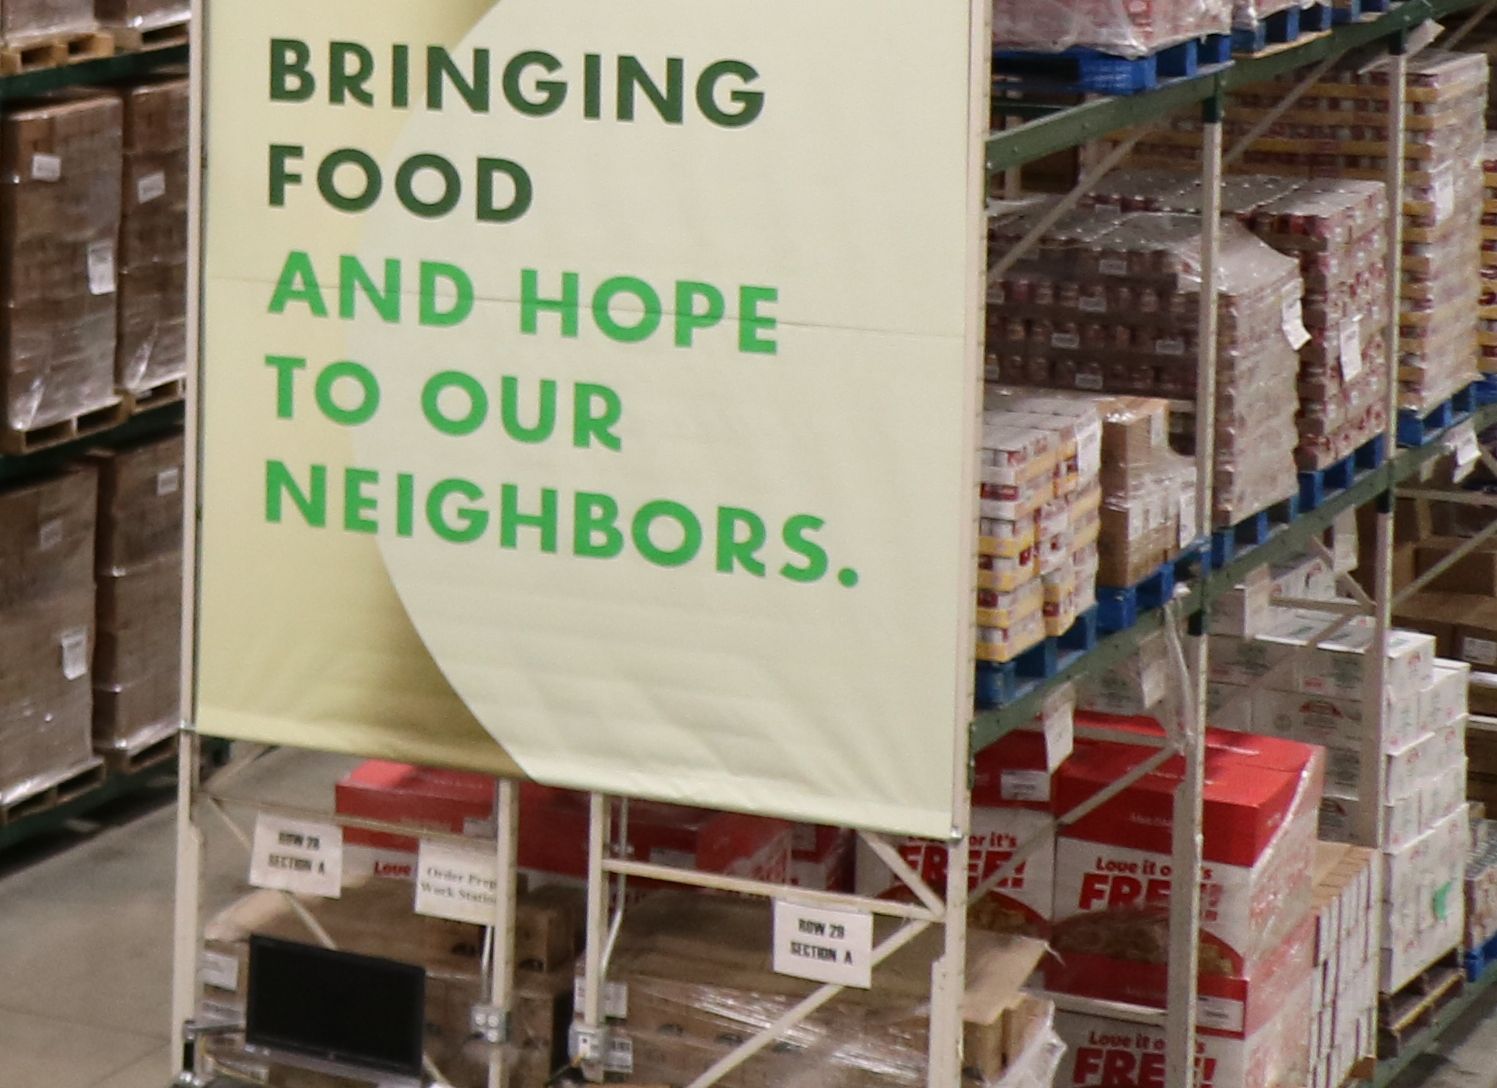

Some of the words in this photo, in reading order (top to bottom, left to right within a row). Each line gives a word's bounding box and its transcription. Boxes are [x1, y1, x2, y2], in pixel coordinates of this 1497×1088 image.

[269, 38, 765, 128] BRINGING
[268, 144, 533, 224] FOOD
[267, 250, 474, 328] AND
[519, 267, 778, 355] HOPE
[265, 354, 381, 426] TO
[421, 370, 622, 452] OUR
[264, 460, 858, 588] NEIGHBORS.
[790, 941, 837, 963] SECTION
[844, 949, 853, 965] A
[798, 918, 825, 936] ROW
